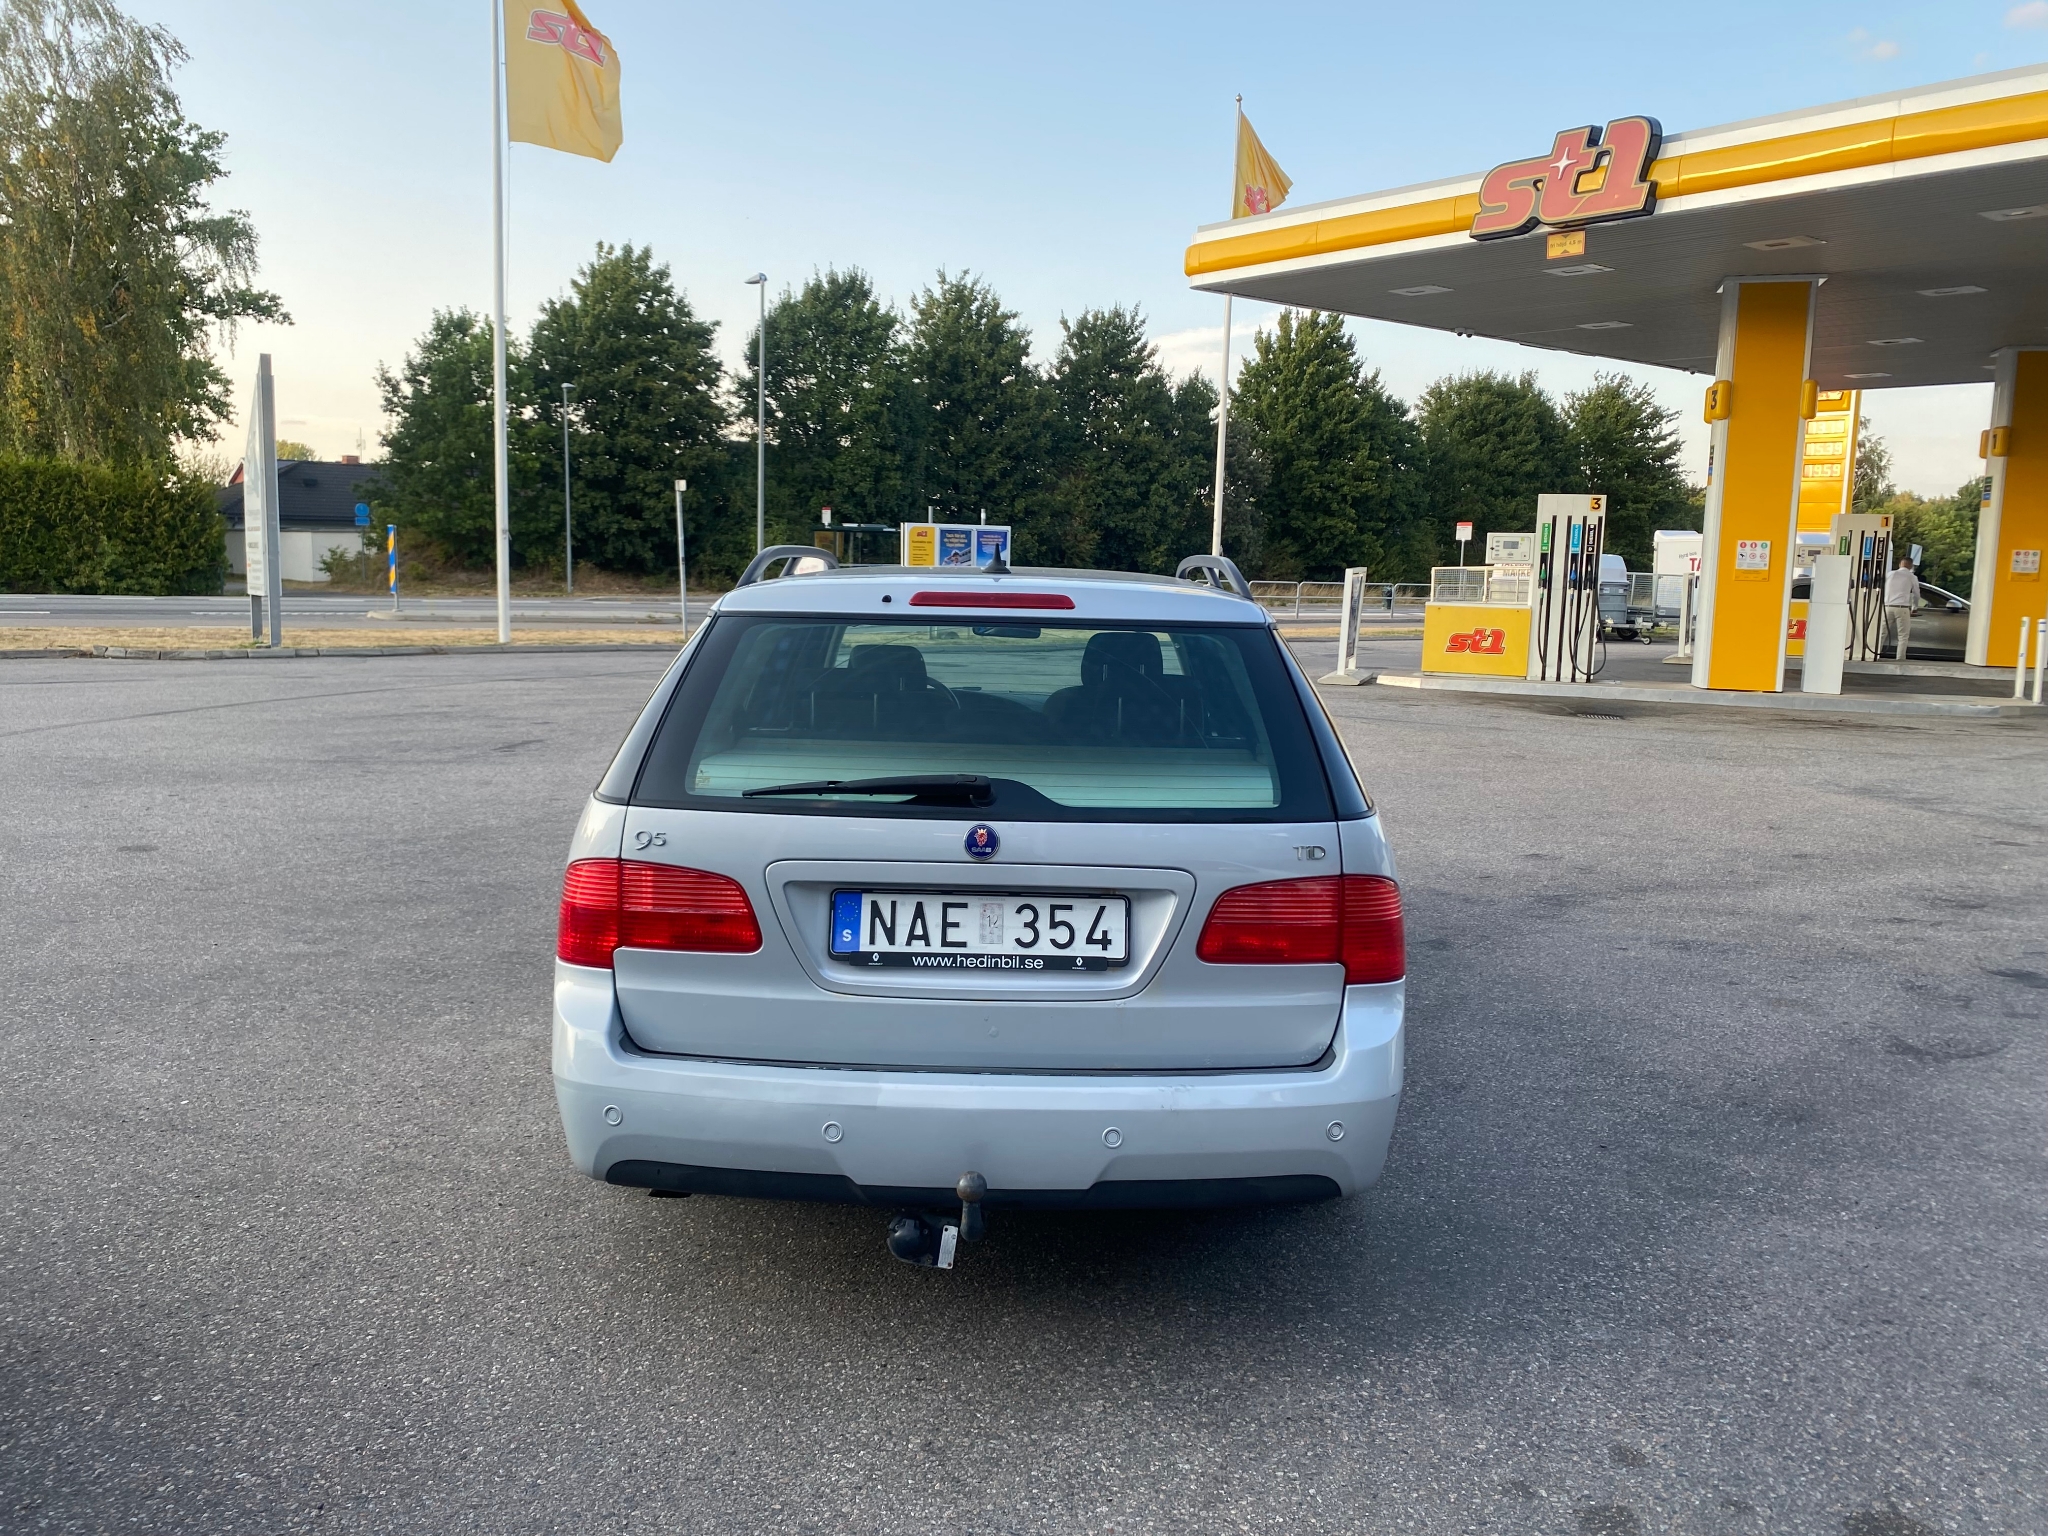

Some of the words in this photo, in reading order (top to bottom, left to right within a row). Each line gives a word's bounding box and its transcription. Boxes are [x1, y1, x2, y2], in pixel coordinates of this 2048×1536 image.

[1470, 115, 1661, 240] st1
[1710, 389, 1718, 410] 3
[1591, 497, 1602, 510] 3
[1883, 517, 1889, 526] 1
[1445, 627, 1506, 655] st1
[634, 830, 667, 851] 95
[842, 929, 852, 942] S
[868, 900, 969, 948] NAE
[1013, 903, 1113, 951] 354
[912, 955, 1044, 970] www.hedinbil.se
